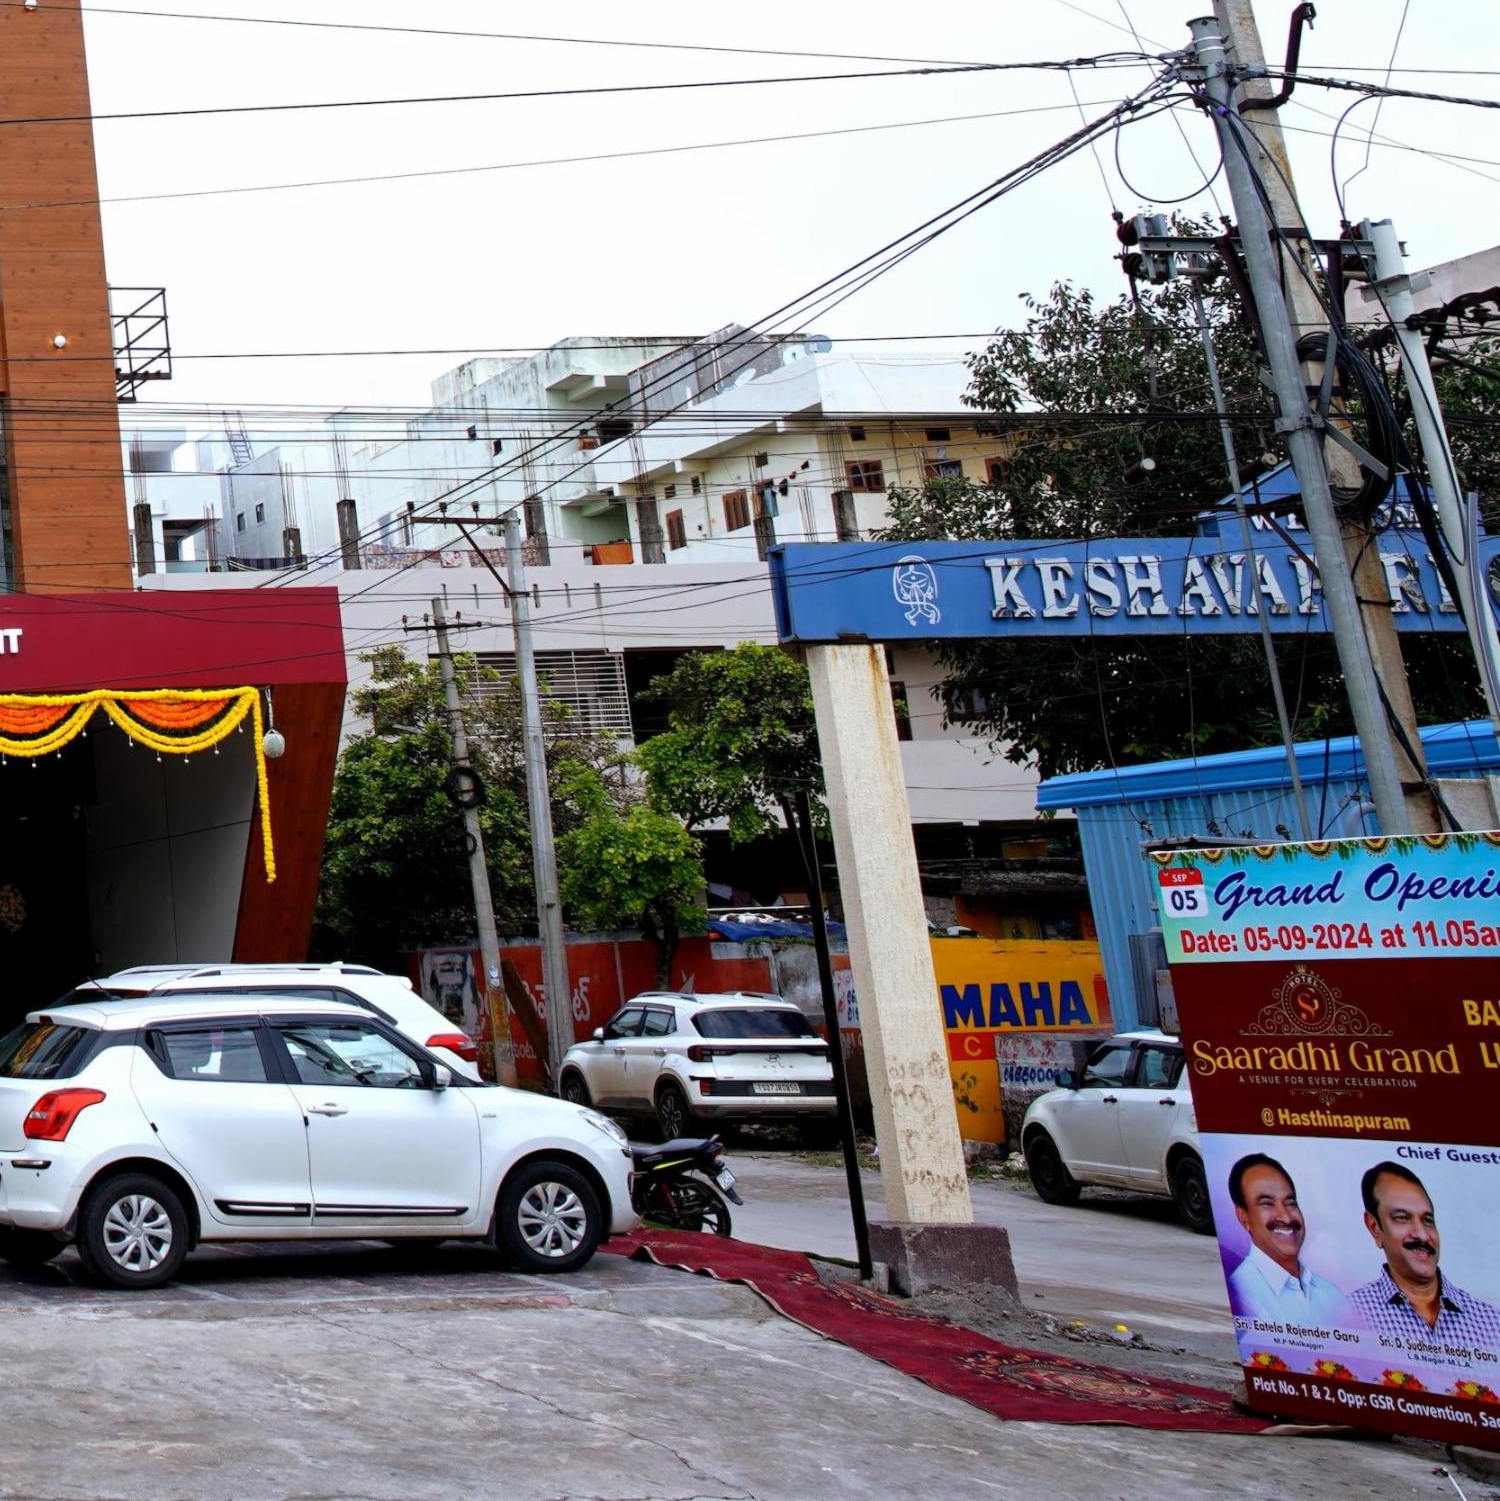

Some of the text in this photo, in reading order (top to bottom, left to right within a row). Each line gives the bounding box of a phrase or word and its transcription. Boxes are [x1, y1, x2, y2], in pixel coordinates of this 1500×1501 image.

[1171, 873, 1187, 883] SEP
[1171, 890, 1198, 911] 05
[1214, 862, 1500, 921] Grand Openi
[1180, 919, 1500, 953] Date: 05-09-2024 at 11.05a
[1288, 976, 1318, 988] HOTEL
[1462, 999, 1500, 1027] BA
[1192, 1039, 1460, 1076] Saaradhi Grand
[1239, 1075, 1417, 1088] A VENUE FOR EVERY CELEBRATION
[1261, 1107, 1410, 1132] @ Hasthinapuram
[1396, 1146, 1500, 1165] Chief Guest
[1235, 1318, 1252, 1330] Sri.
[1286, 1324, 1330, 1340] Rajender
[1333, 1330, 1360, 1343] Garu
[1379, 1335, 1498, 1363] Sri. D. Sudheer Reddy Garu
[1253, 1376, 1477, 1427] Plot No. 1 & 2, Opp: GSR Convention,
